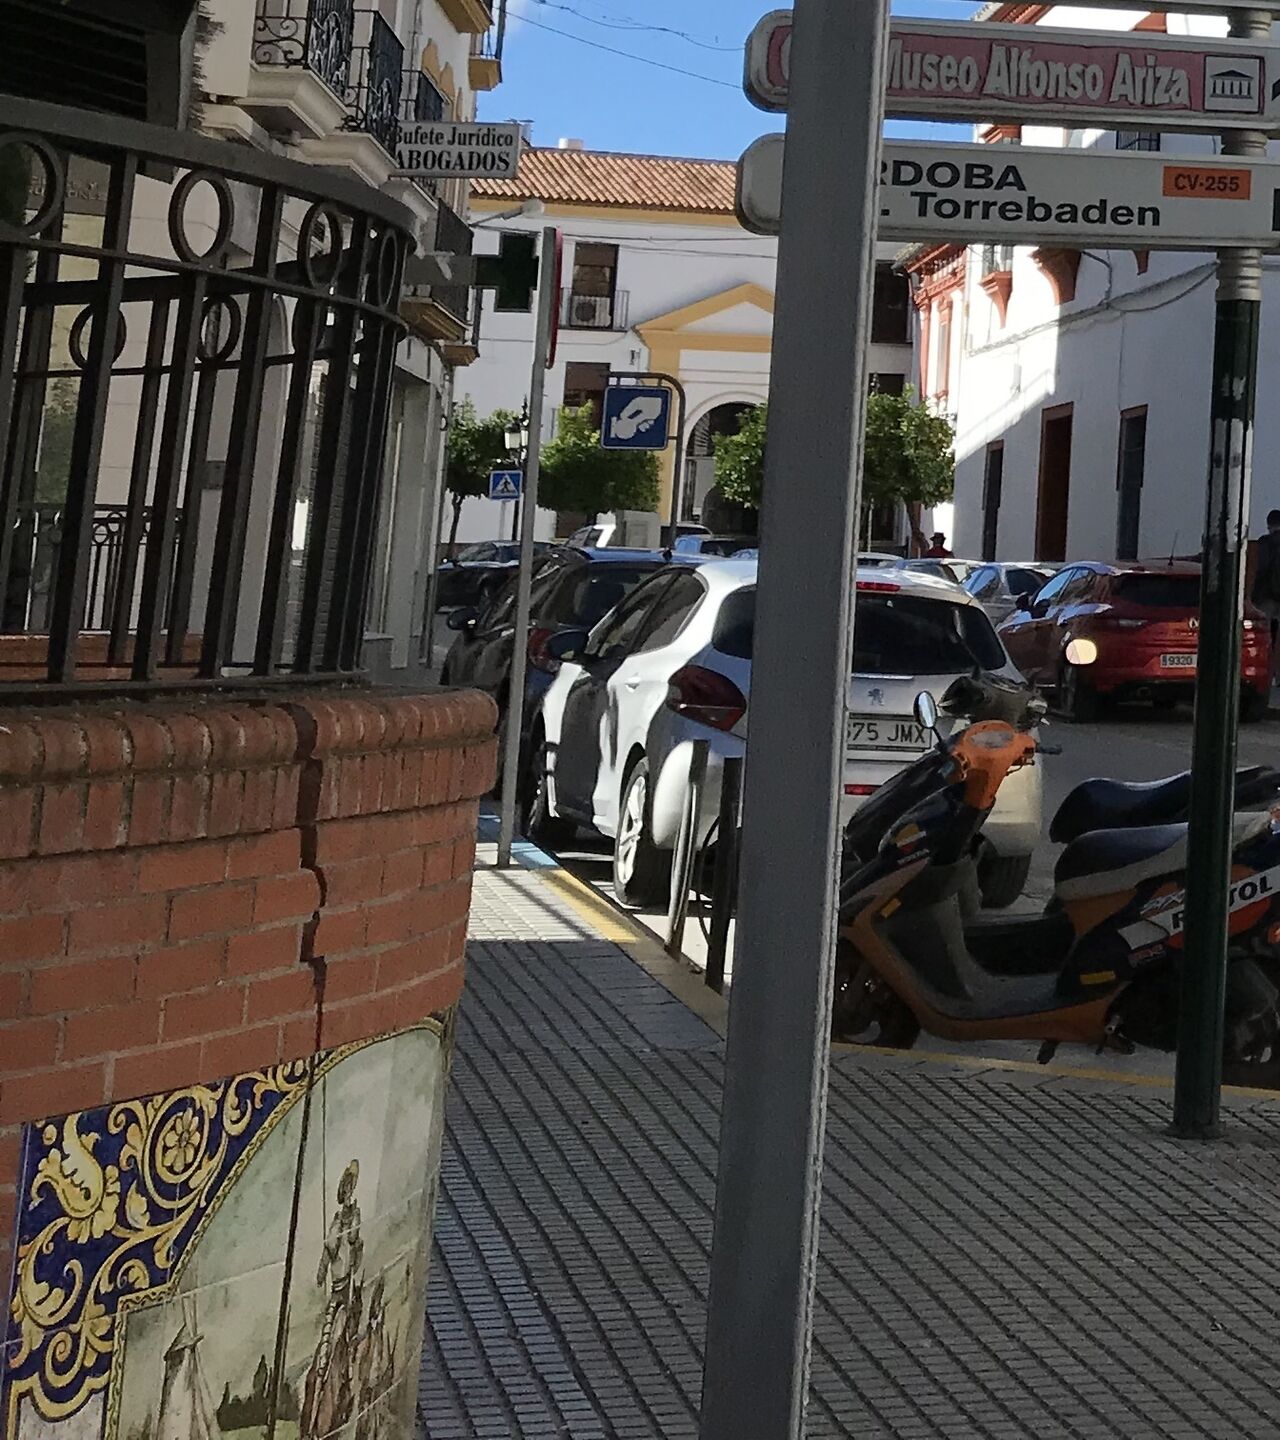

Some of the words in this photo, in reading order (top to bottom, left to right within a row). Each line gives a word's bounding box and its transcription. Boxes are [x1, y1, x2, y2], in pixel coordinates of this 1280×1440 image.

[982, 42, 1104, 101] Alfonso
[1109, 53, 1194, 108] Ariza
[447, 126, 513, 146] Jurídico
[396, 149, 510, 172] ABOGADOS
[1174, 173, 1240, 192] CV-255
[910, 191, 1160, 227] Torrebaden
[887, 724, 926, 744] JMX
